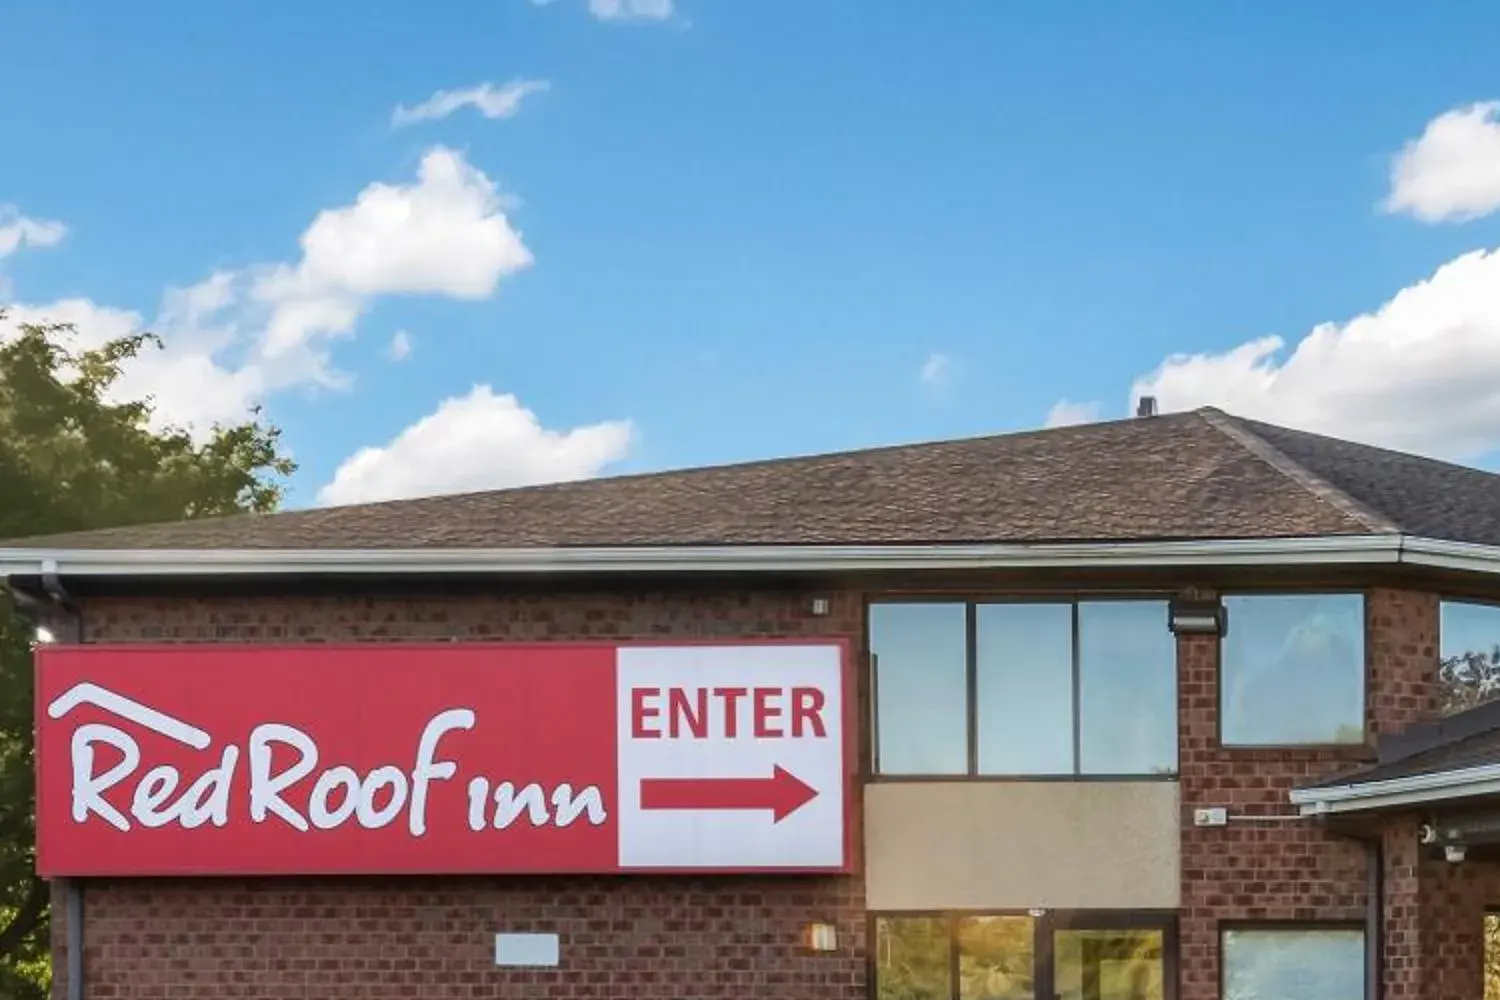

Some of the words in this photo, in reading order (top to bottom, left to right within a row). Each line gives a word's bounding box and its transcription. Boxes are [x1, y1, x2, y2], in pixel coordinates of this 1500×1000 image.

[631, 686, 827, 739] ENTER
[71, 723, 240, 832] Red
[249, 708, 475, 837] Roof
